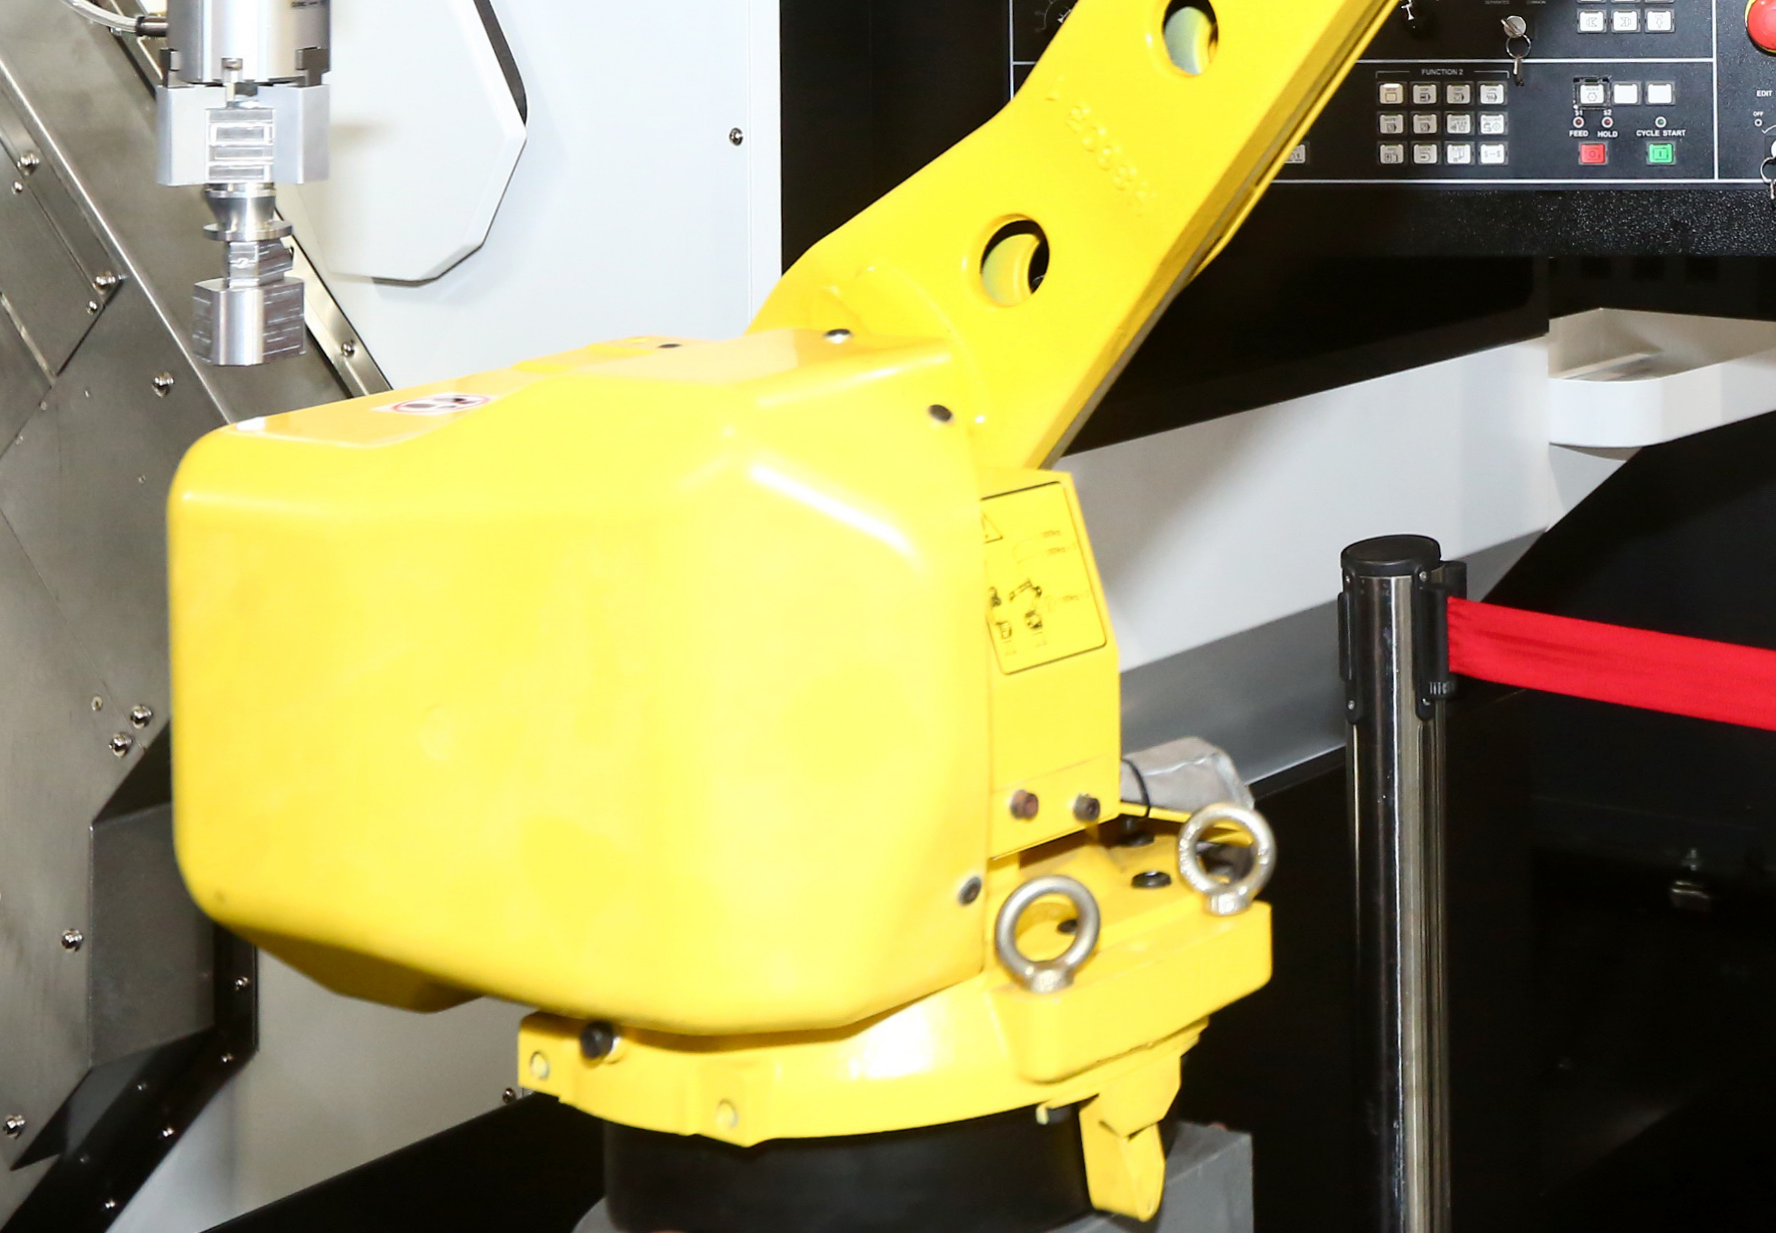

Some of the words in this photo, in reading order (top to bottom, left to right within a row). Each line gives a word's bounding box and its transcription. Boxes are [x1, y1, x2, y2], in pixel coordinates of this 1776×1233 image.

[1421, 68, 1458, 76] FUNCTION
[1597, 130, 1618, 138] HOLD
[1636, 129, 1660, 137] CYCLE
